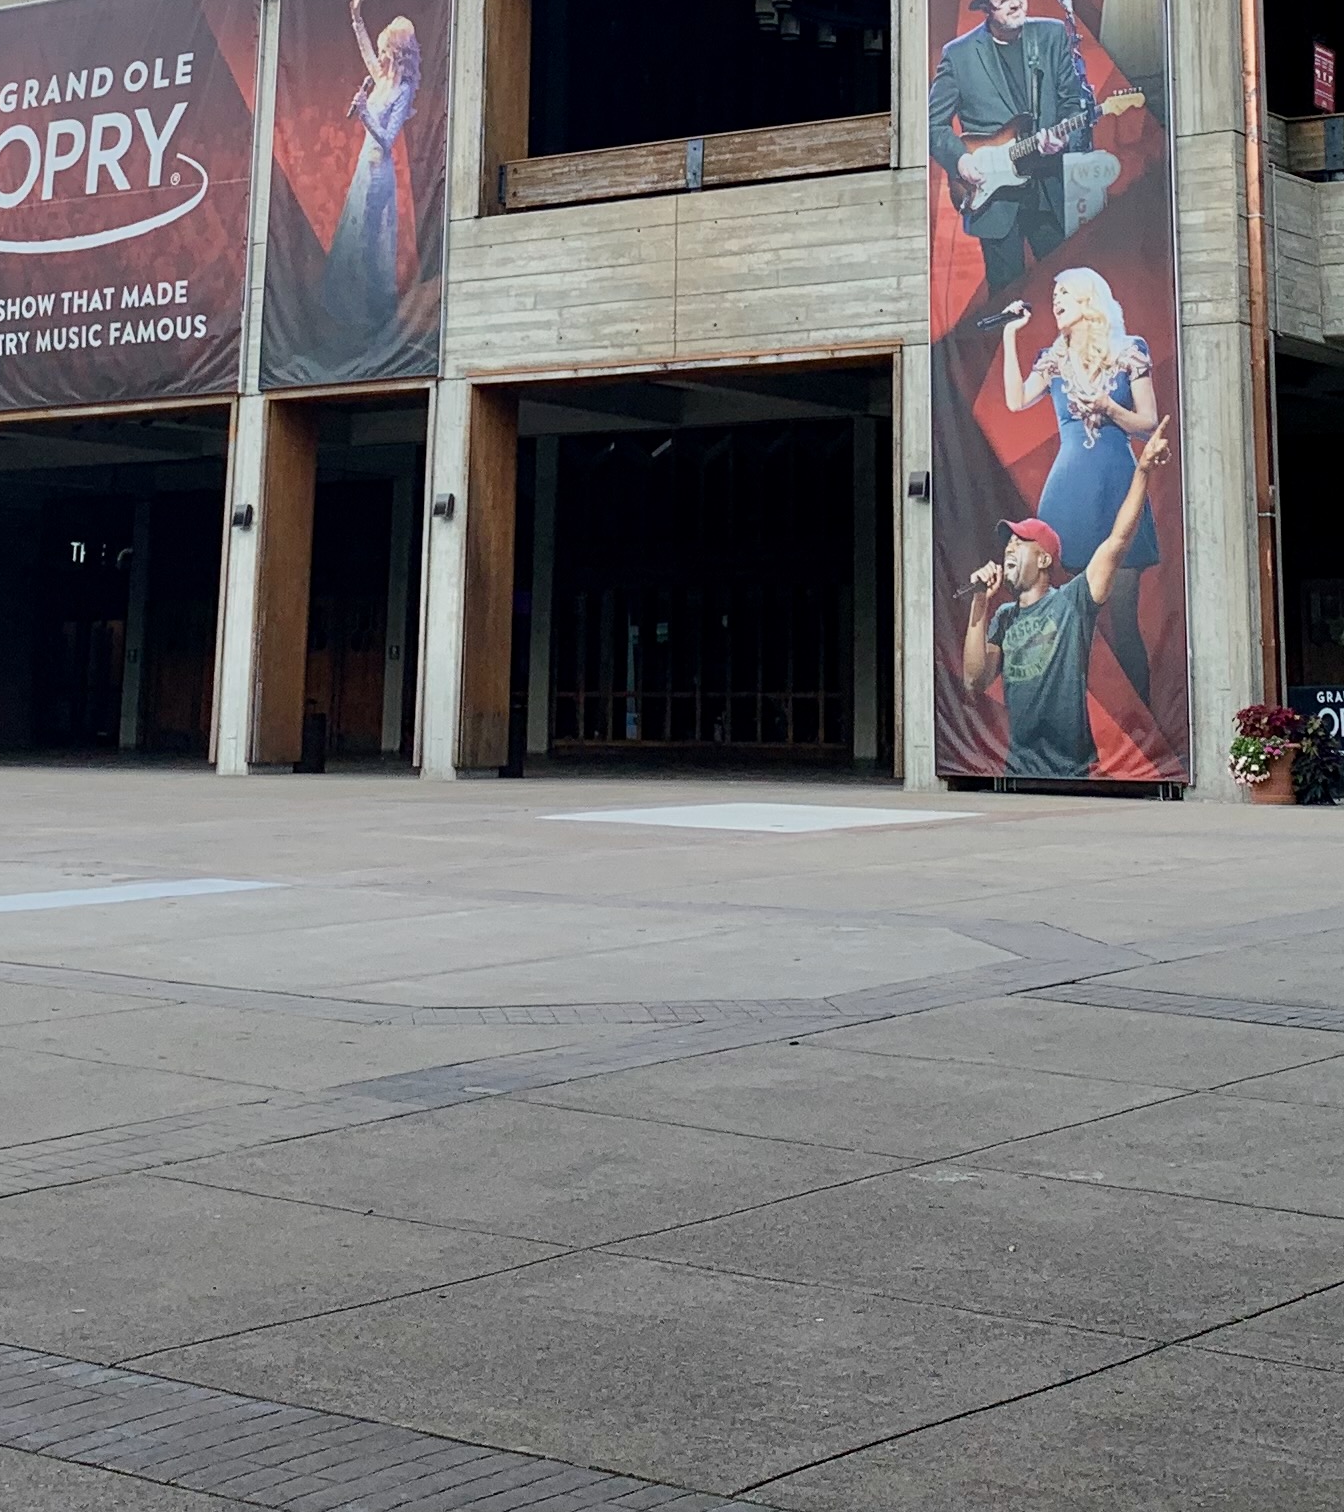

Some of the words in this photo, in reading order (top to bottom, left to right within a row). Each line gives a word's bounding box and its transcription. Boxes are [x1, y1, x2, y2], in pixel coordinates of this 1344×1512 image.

[123, 52, 194, 92] OLE
[61, 287, 115, 314] THAT
[121, 280, 188, 308] MADE
[35, 323, 102, 353] MUSIC
[109, 315, 207, 346] FAMOUS
